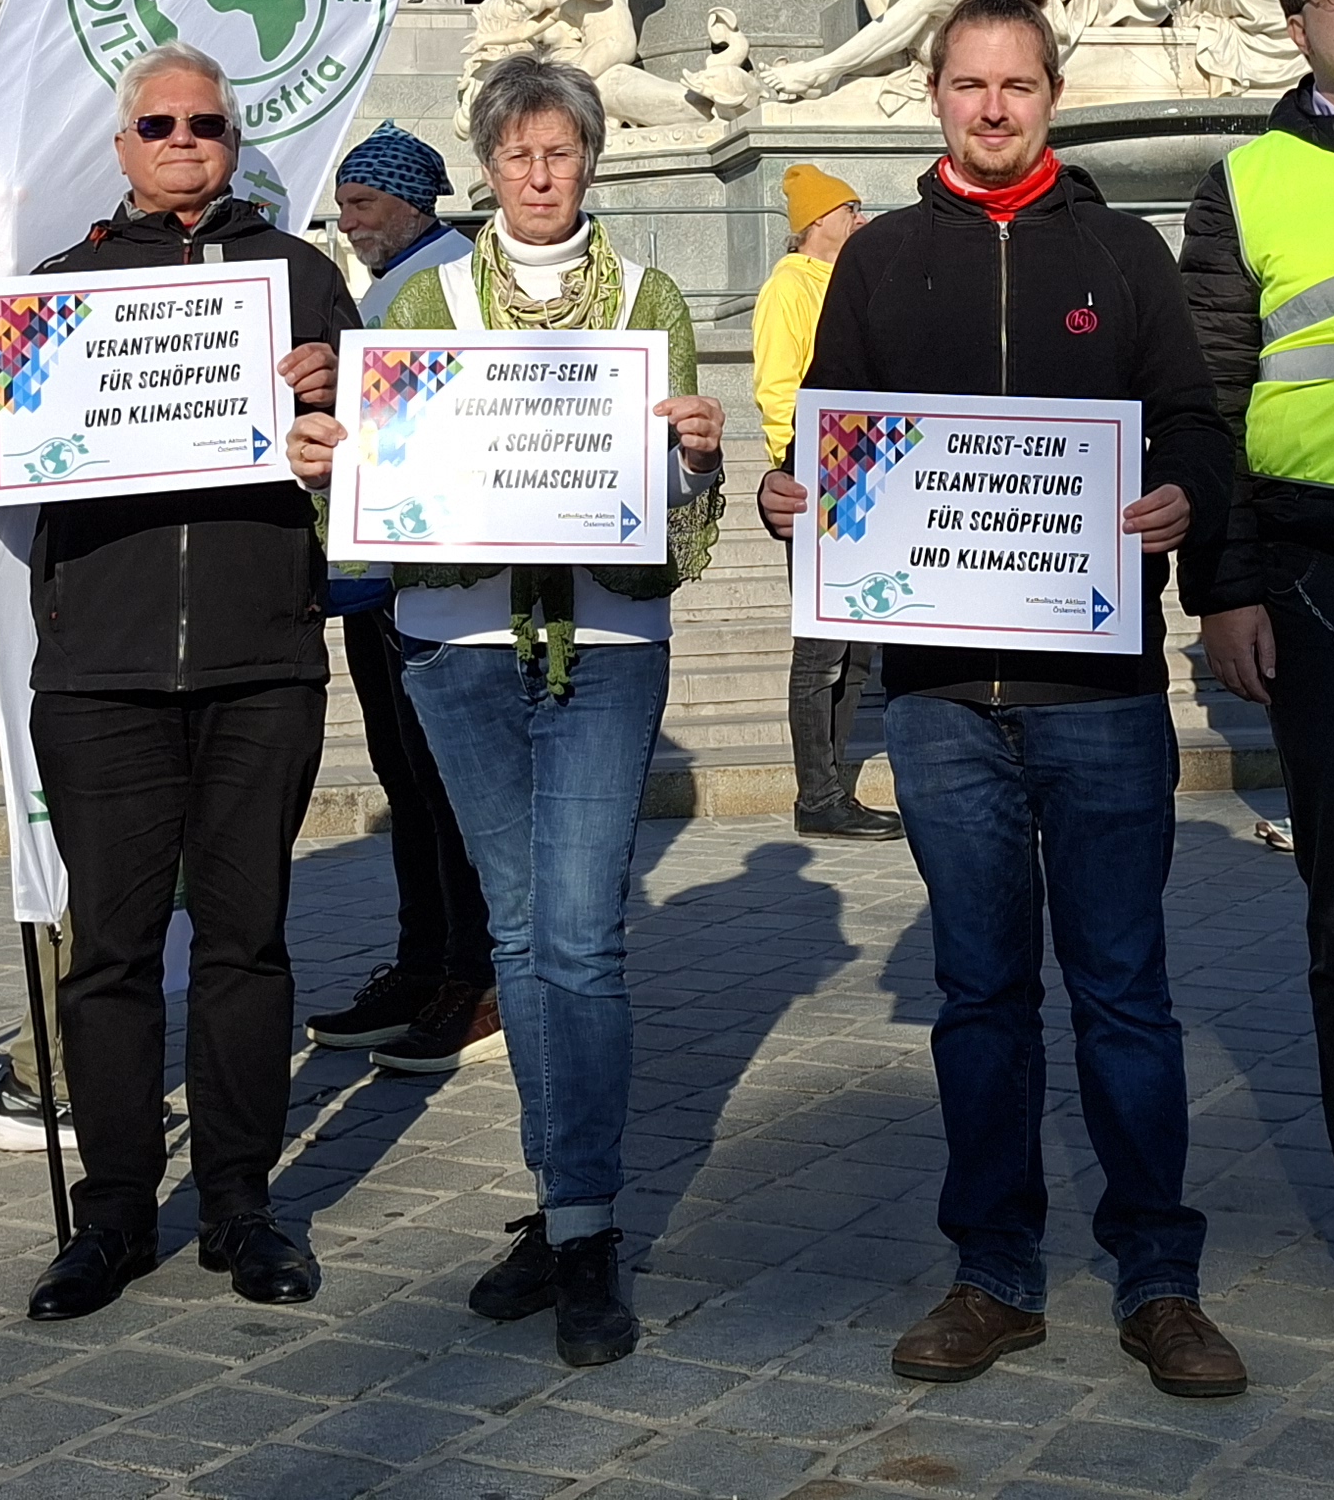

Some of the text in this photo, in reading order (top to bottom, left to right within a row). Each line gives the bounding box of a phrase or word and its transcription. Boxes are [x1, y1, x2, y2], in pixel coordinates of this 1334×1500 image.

[245, 54, 346, 128] ustria
[115, 297, 223, 323] CHRIST-SEIN
[86, 330, 239, 359] VERANTWORTUNG
[99, 363, 241, 392] FÜR SCHÖPFUNG
[486, 363, 598, 382] CHRIST-SEIN
[84, 397, 248, 428] UND KLIMASCHUTZ
[454, 397, 613, 417] VERANTWORTUNG
[505, 429, 613, 453] SCHÖPFUNG
[947, 433, 1067, 458] CHRIST-SEIN
[492, 469, 619, 489] KLIMASCHUTZ
[915, 470, 1083, 496] VERANTWORTUNG
[622, 518, 637, 526] KA
[927, 504, 1083, 535] FÜR SCHÖPFUNG
[909, 546, 1090, 574] UND KLIMASCHUTZ
[1094, 605, 1110, 613] KA
